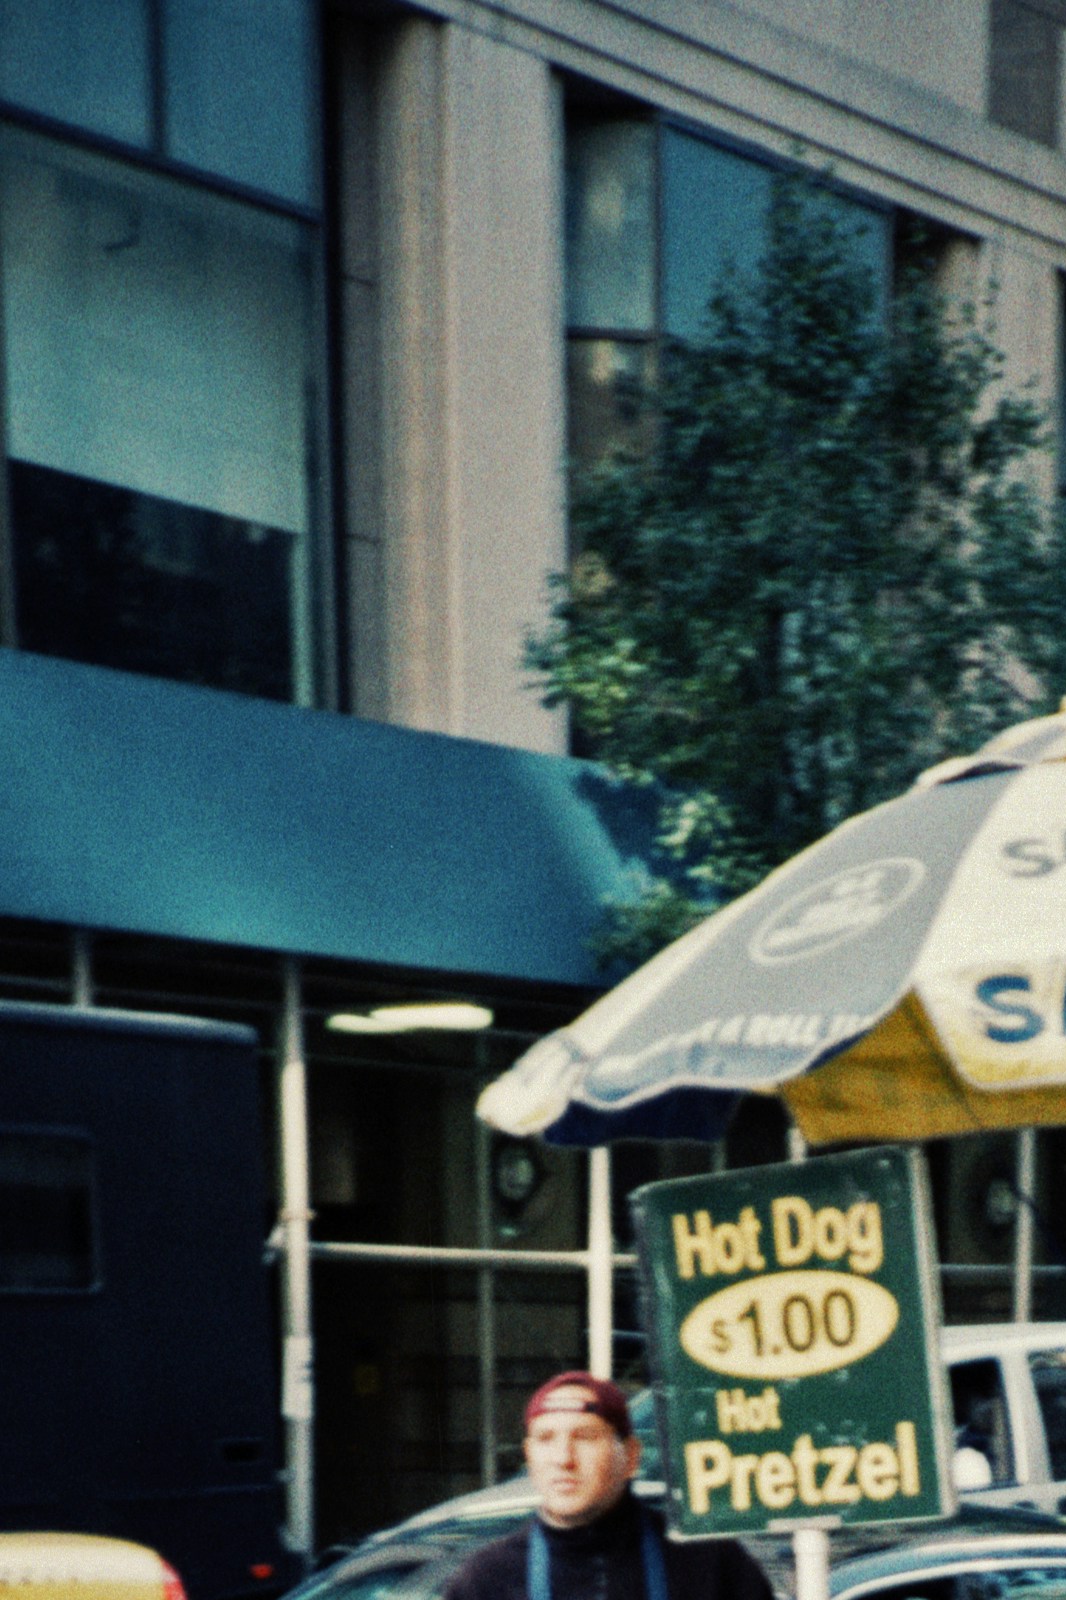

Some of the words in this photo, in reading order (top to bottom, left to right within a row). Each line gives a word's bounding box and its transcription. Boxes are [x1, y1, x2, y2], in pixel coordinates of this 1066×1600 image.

[671, 1205, 765, 1280] Hot
[771, 1196, 884, 1274] Dog
[711, 1287, 858, 1358] $1.00
[715, 1386, 782, 1434] Hot
[684, 1420, 920, 1514] Pretzel
